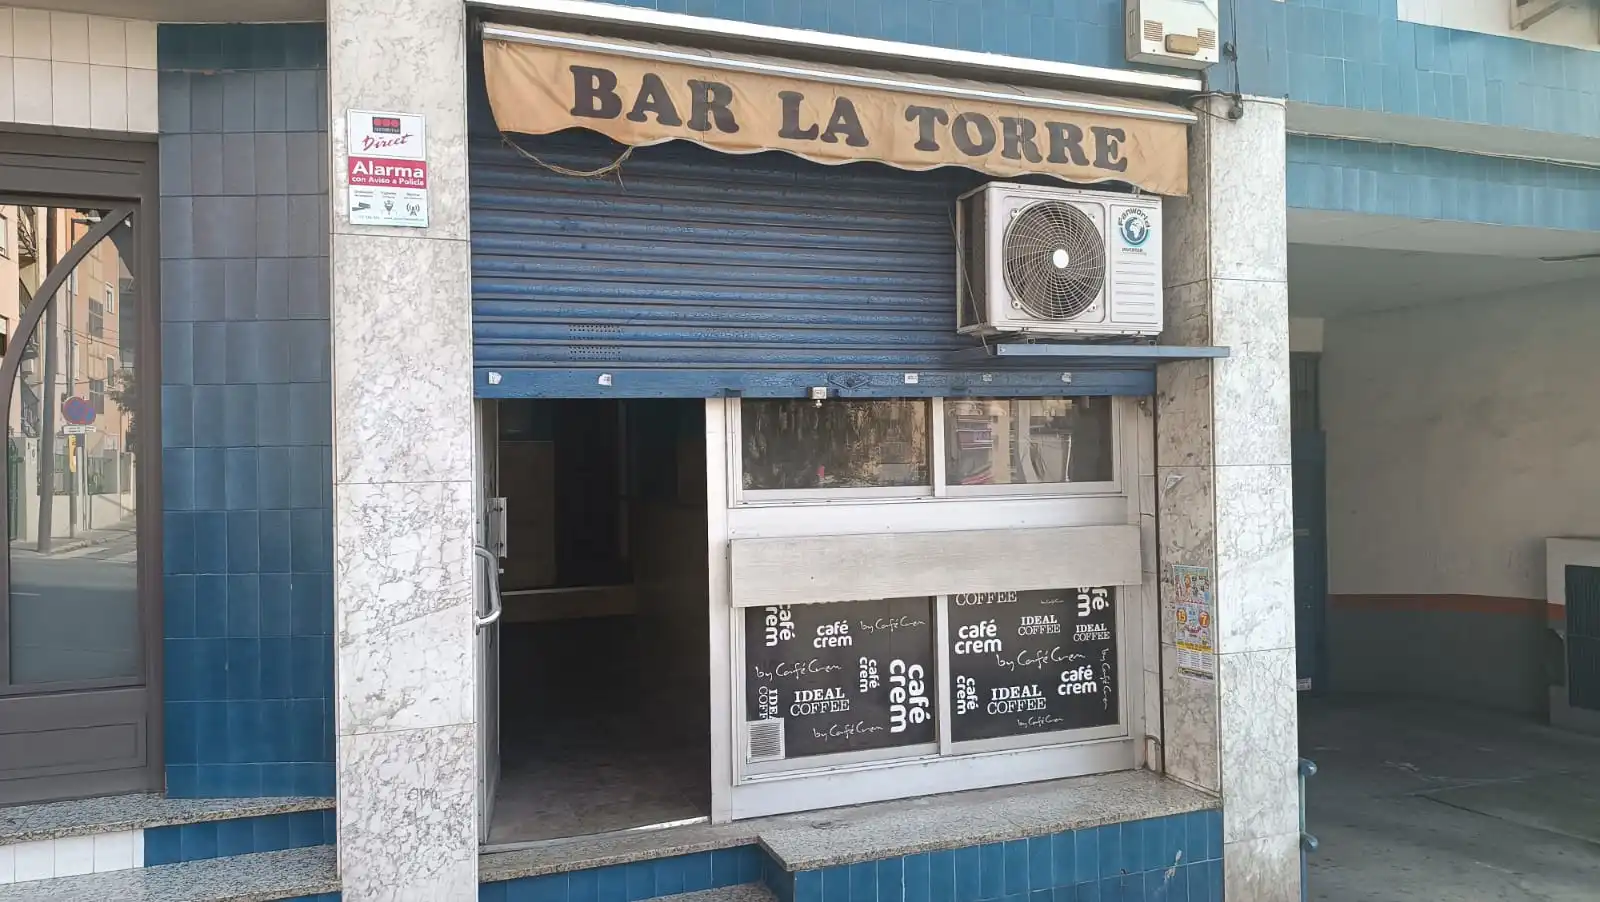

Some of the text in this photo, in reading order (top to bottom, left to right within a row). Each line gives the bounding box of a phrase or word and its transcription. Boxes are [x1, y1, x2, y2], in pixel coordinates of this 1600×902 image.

[569, 64, 1128, 173] BAR LA TORRE
[361, 133, 414, 151] Direct
[352, 160, 424, 178] Alarma
[368, 176, 390, 184] Aviso
[1118, 207, 1151, 228] Fanworld
[1092, 587, 1109, 610] fé
[765, 606, 778, 647] rem
[816, 619, 849, 636] café
[860, 621, 874, 633] by
[958, 618, 997, 639] café
[1021, 614, 1058, 626] IDEAL
[1075, 623, 1108, 633] IDEAL
[1017, 624, 1061, 636] COFFEE
[1073, 631, 1110, 642] COFFEE
[813, 635, 852, 649] crem
[954, 638, 1002, 655] crem
[996, 654, 1014, 671] by
[754, 666, 773, 681] by
[859, 656, 868, 693] crem
[868, 659, 881, 689] café
[1060, 664, 1093, 682] café
[794, 687, 845, 703] IDEAL
[889, 659, 906, 733] crem
[908, 664, 931, 724] café
[956, 675, 966, 715] crem
[966, 677, 979, 710] café
[991, 684, 1042, 701] IDEAL
[1057, 681, 1097, 696] crem
[758, 685, 768, 720] COFF
[790, 699, 850, 717] COFFEE
[987, 697, 1047, 715] COFFEE
[812, 727, 828, 741] by
